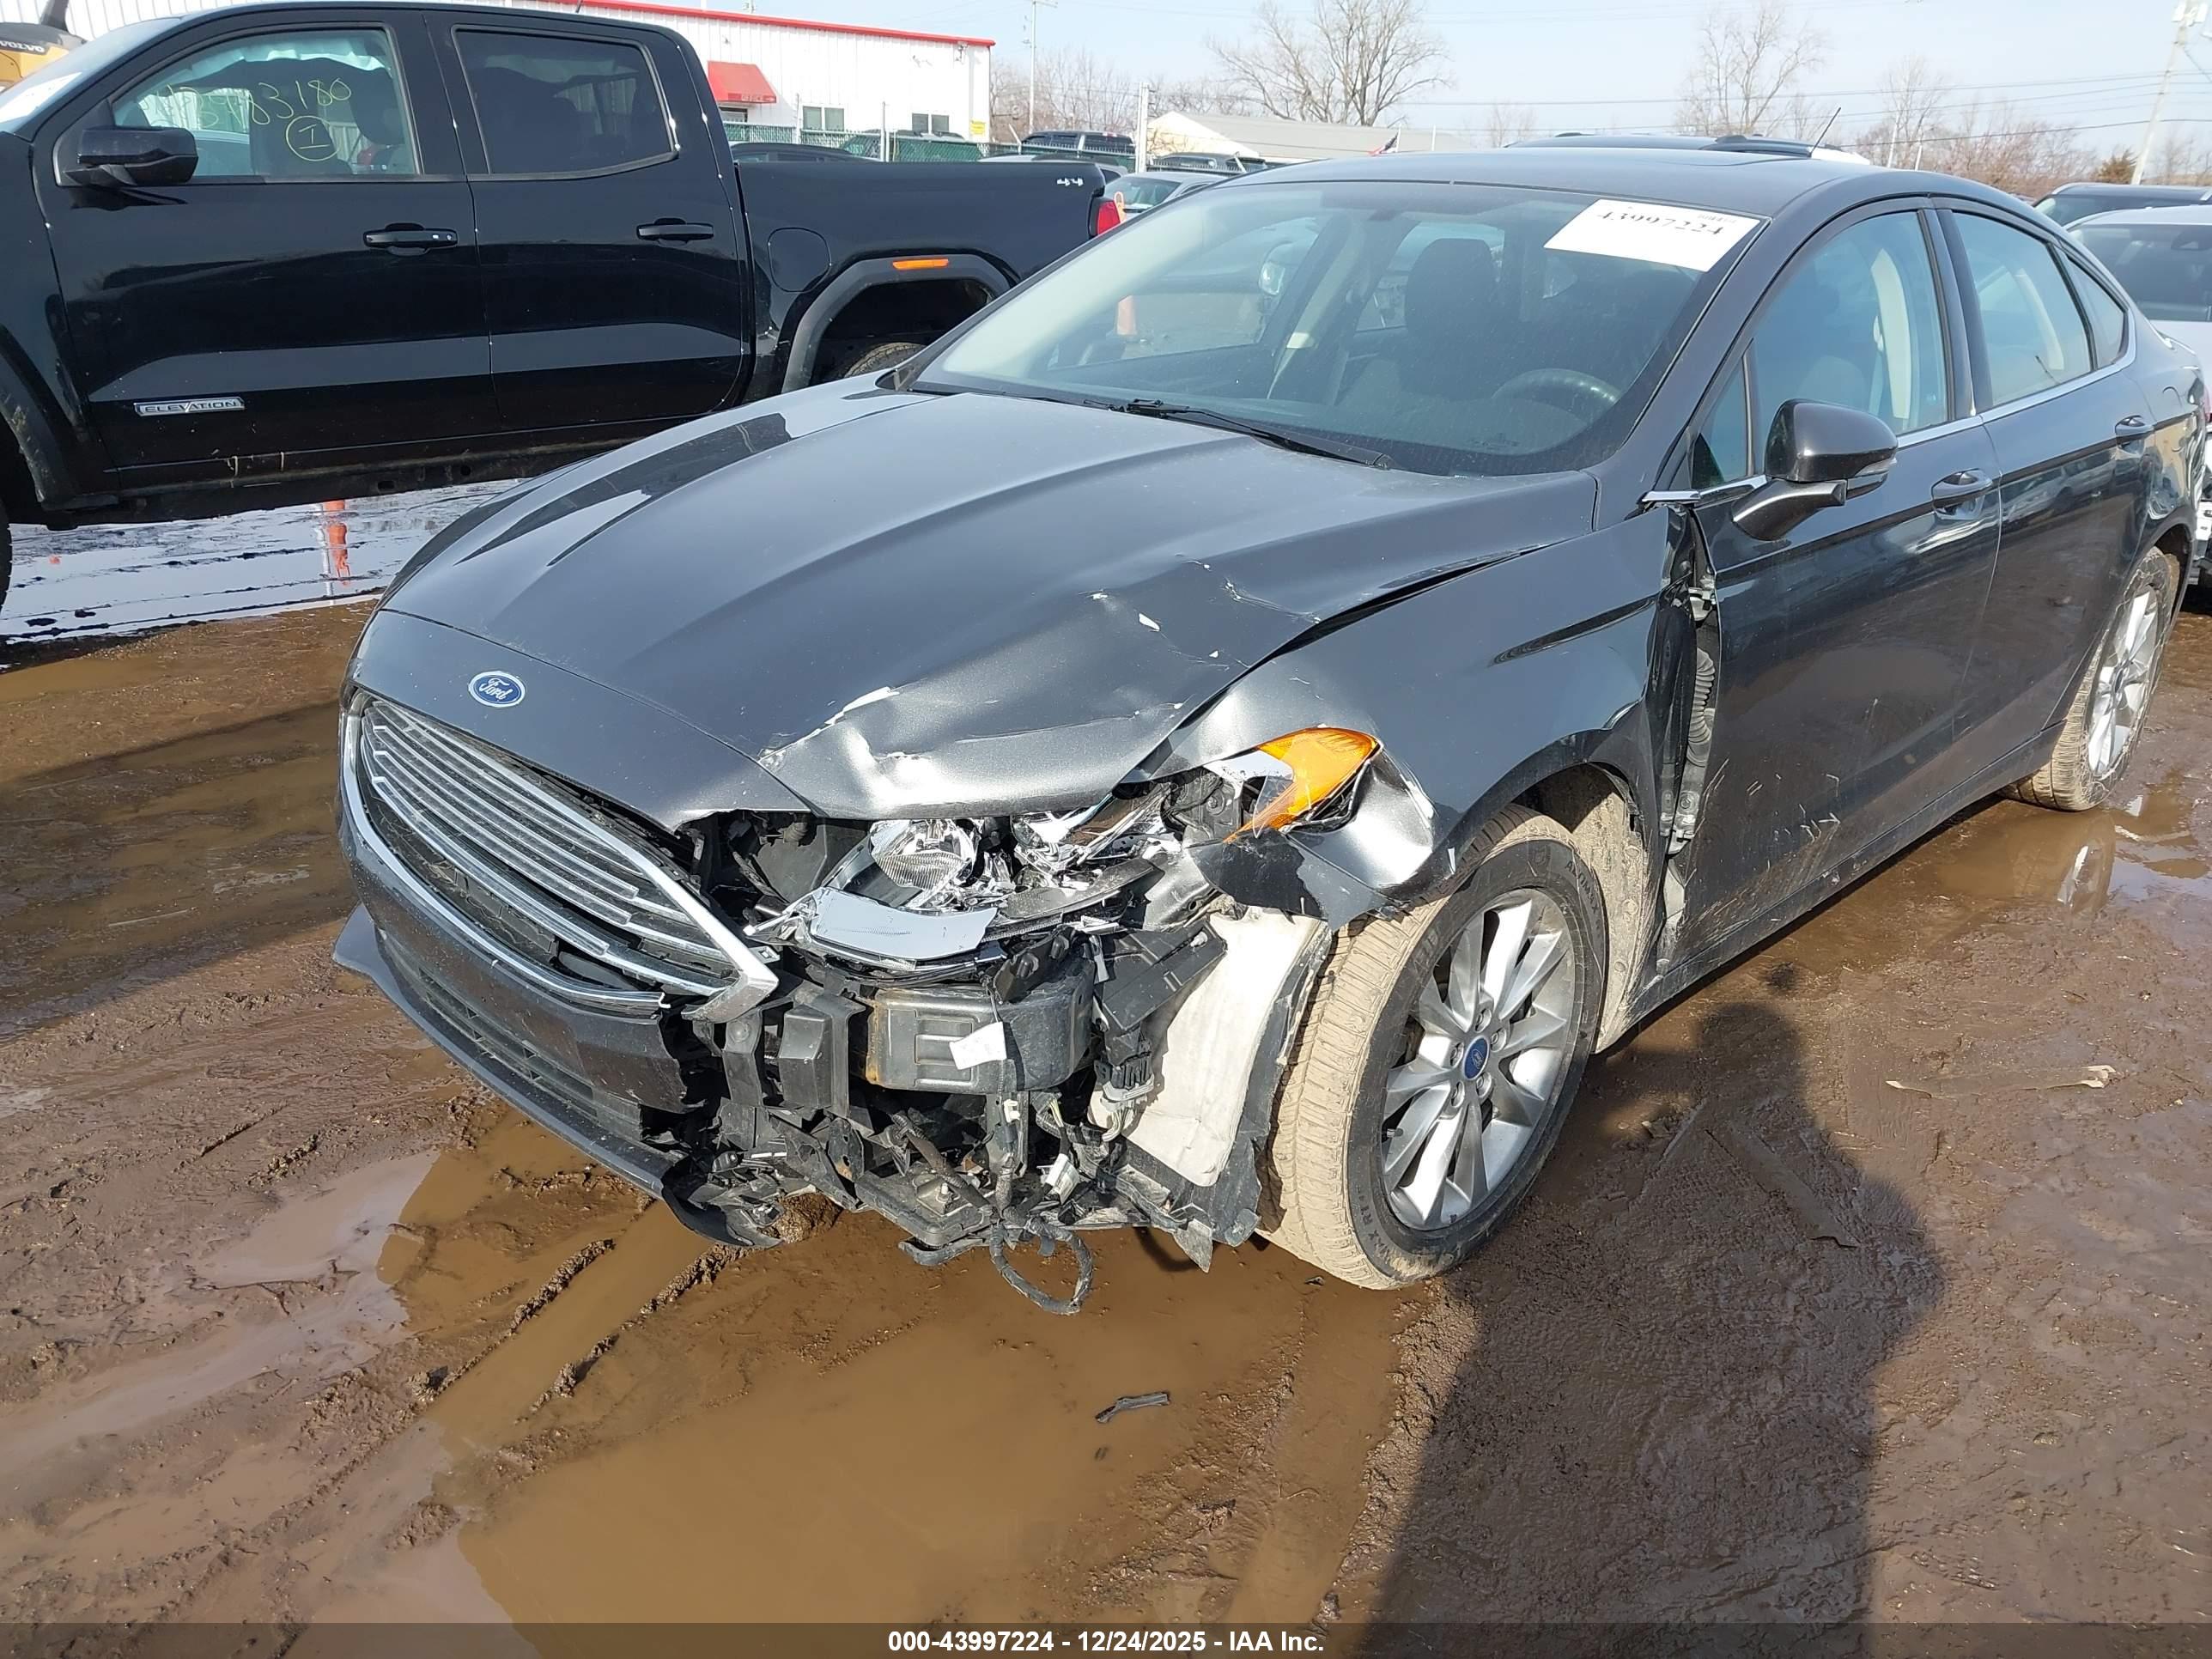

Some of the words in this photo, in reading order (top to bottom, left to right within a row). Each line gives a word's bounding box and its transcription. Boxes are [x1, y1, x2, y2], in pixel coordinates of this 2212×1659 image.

[0, 40, 46, 53] VOLVO
[144, 400, 237, 413] ELEVATION
[478, 678, 514, 701] Ford
